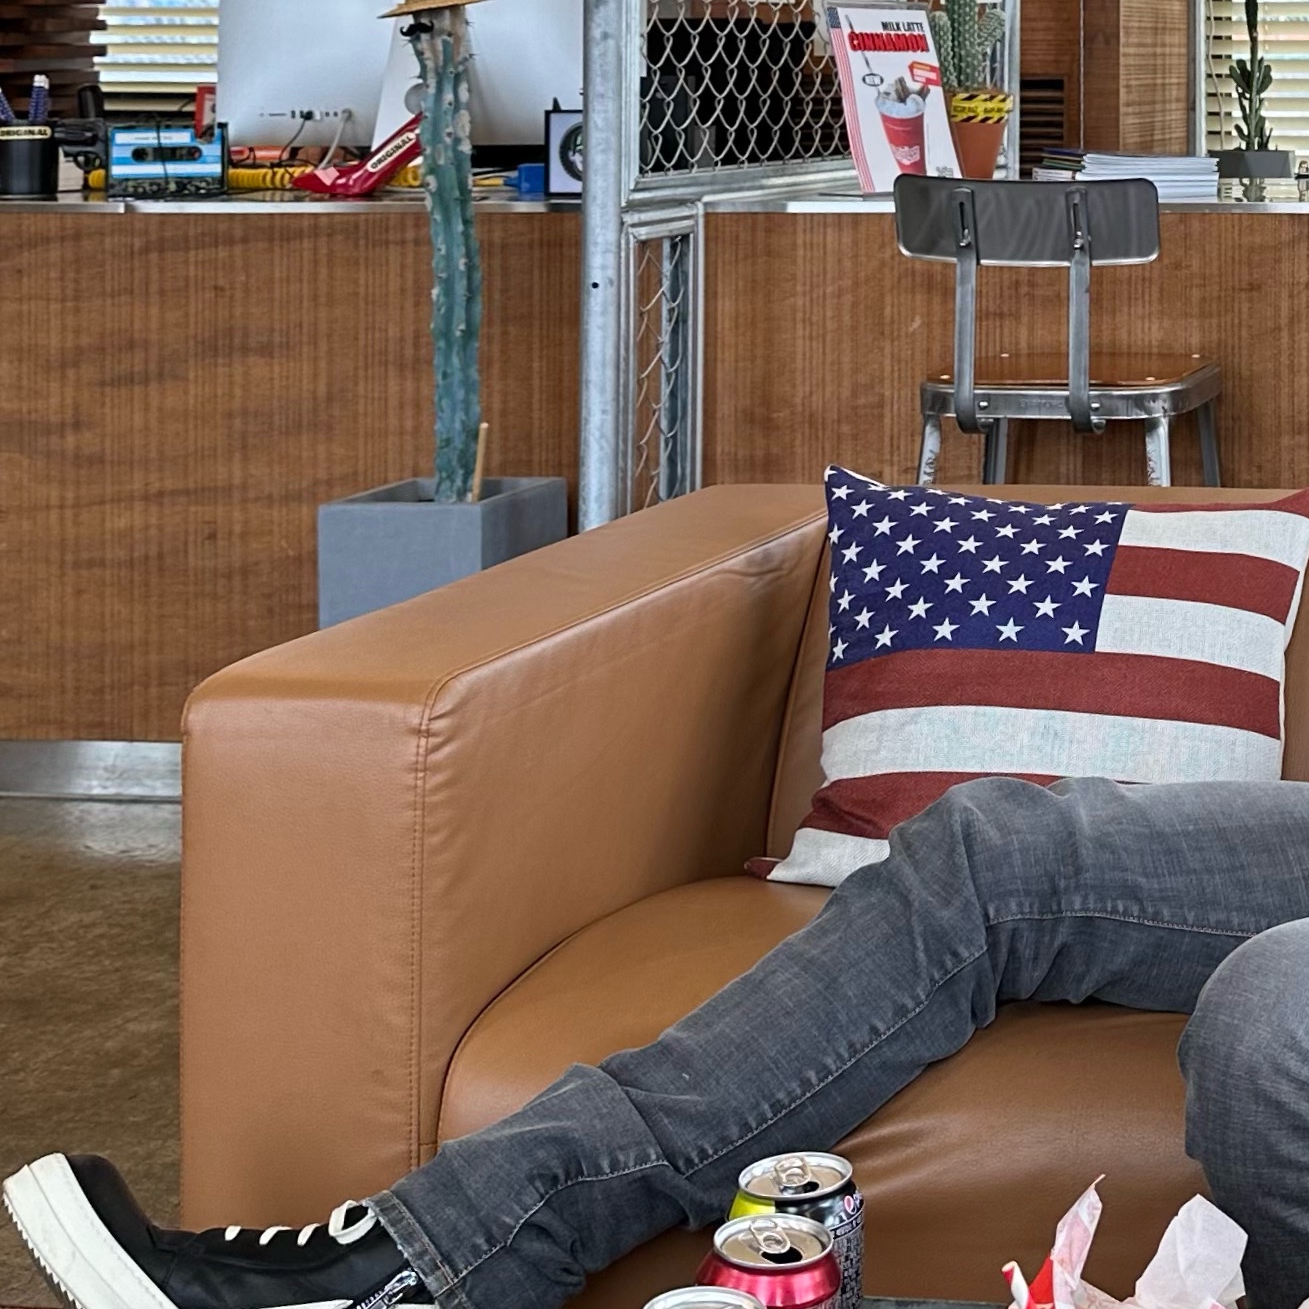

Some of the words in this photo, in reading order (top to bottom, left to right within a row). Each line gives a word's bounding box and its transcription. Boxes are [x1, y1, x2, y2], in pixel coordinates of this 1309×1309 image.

[881, 21, 902, 32] MILK
[902, 22, 925, 33] LATTE
[848, 30, 929, 53] CINNAMON
[370, 135, 412, 170] ORIGINAL
